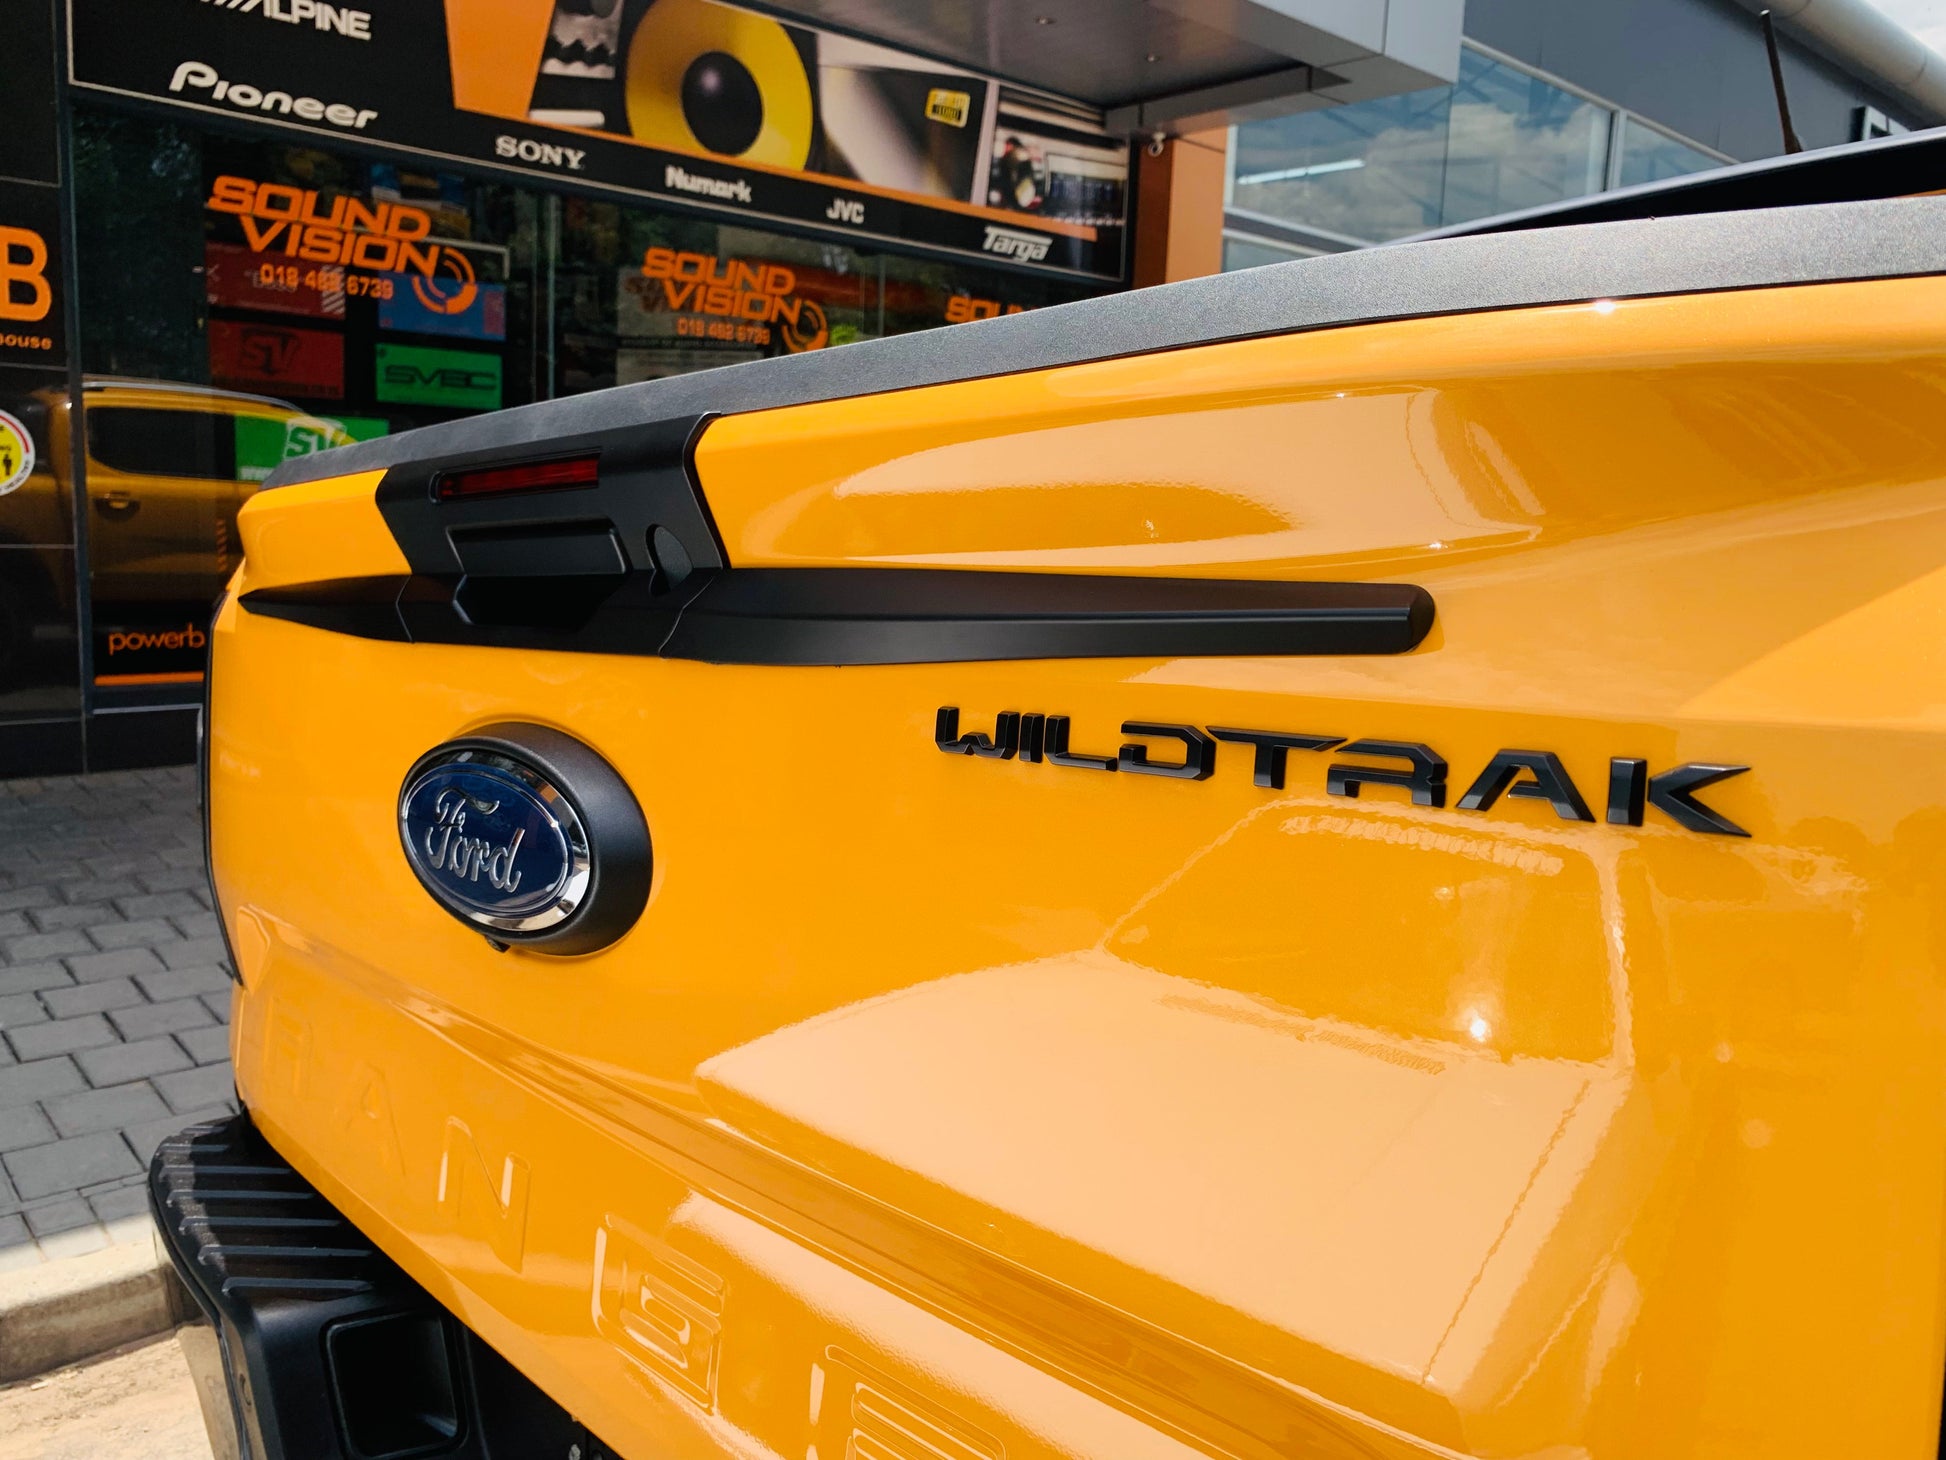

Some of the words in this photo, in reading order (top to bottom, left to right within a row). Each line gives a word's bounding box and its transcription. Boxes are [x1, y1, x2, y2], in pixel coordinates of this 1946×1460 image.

[169, 61, 379, 129] Pioneer
[495, 135, 586, 170] SONY
[665, 165, 752, 203] Numark
[208, 175, 432, 241] SOUND
[826, 198, 865, 225] JVC
[239, 213, 441, 277] VISION
[982, 225, 1054, 263] Targa
[260, 263, 299, 289] 018
[641, 246, 796, 296] SOUND
[662, 278, 803, 325] VISION
[0, 334, 52, 350] ouse
[108, 622, 206, 656] powerb
[935, 705, 1753, 838] WILDTRAK
[425, 787, 526, 893] Ford
